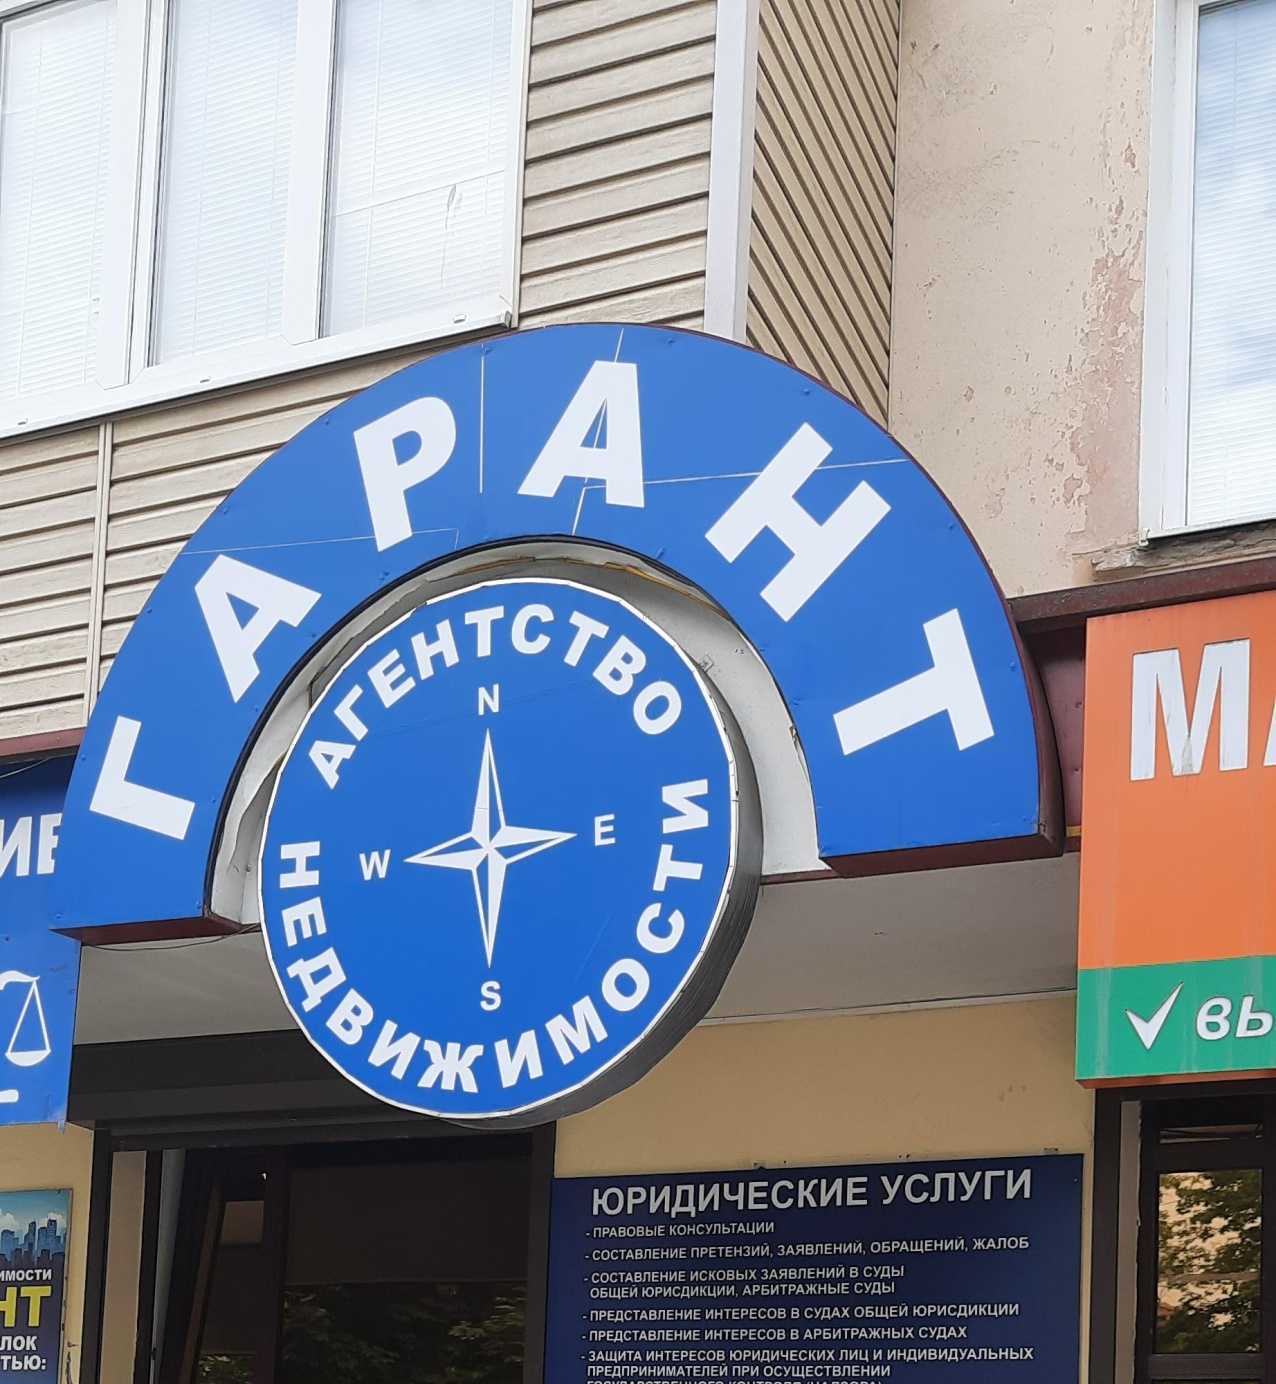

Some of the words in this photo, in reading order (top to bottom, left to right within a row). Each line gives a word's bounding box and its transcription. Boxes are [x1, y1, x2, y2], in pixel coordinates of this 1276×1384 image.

[89, 360, 995, 840] ГАРАНТ
[308, 604, 682, 789] АГЕНТСТВО
[478, 684, 499, 716] N
[1130, 638, 1276, 781] М
[359, 850, 391, 881] W
[594, 815, 616, 846] E
[279, 778, 710, 1093] НЕДВИЖИМОСТИ
[480, 981, 502, 1011] S
[592, 1176, 868, 1218] ЮРИДИЧЕСКИЕ
[881, 1169, 1031, 1204] УСЛУГИ
[593, 1226, 665, 1239] ПРАВОВЫЕ
[669, 1222, 775, 1237] КОНСУЛЬТАЦИИ
[592, 1248, 687, 1261] СОСТАВЛЕНИЕ
[690, 1243, 774, 1259] ПРЕТЕНЗИЙ,
[777, 1240, 866, 1257] ЗАЯВЛЕНИЙ,
[870, 1236, 968, 1254] ОБРАЩЕНИЙ,
[972, 1236, 1029, 1251] ЖАЛОБ
[591, 1271, 686, 1284] СОСТАВЛЕНИЕ
[690, 1269, 757, 1282] ИСКОВЫХ
[760, 1265, 845, 1281] ЗАЯВЛЕНИЙ
[850, 1266, 859, 1278] В
[863, 1265, 904, 1279] СУДЫ
[590, 1284, 638, 1300] ОБЩЕЙ
[641, 1285, 739, 1300] ЮРИСДИКЦИИ,
[742, 1282, 850, 1297] АРБИТРАЖНЫЕ
[854, 1281, 895, 1296] СУДЫ
[590, 1309, 701, 1322] ПРЕДСТАВЛЕНИЕ
[705, 1307, 787, 1320] ИНТЕРЕСОВ
[790, 1307, 800, 1319] В
[804, 1306, 850, 1320] СУДАХ
[854, 1302, 908, 1319] ОБЩЕЙ
[912, 1303, 1020, 1318] ЮРИСДИКЦИИ
[589, 1329, 701, 1342] ПРЕДСТАВЛЕНИЕ
[704, 1328, 786, 1341] ИНТЕРЕСОВ
[790, 1328, 800, 1340] В
[803, 1327, 914, 1340] АРБИТРАЖНЫХ
[918, 1326, 967, 1340] СУДАХ
[588, 1350, 642, 1363] ЗАЩИТА
[646, 1350, 725, 1362] ИНТЕРЕСОВ
[729, 1349, 834, 1362] ЮРИДИЧЕСКИХ
[839, 1349, 869, 1362] ЛИЦ
[873, 1349, 883, 1361] И
[887, 1347, 1034, 1362] ИНДИВИДУАЛЬНЫХ
[587, 1363, 728, 1378] ПРЕДПРИНИМАТЕЛЕЙ
[732, 1365, 759, 1377] ПРИ
[763, 1365, 891, 1378] ОСУЩЕСТВЛЕНИИ
